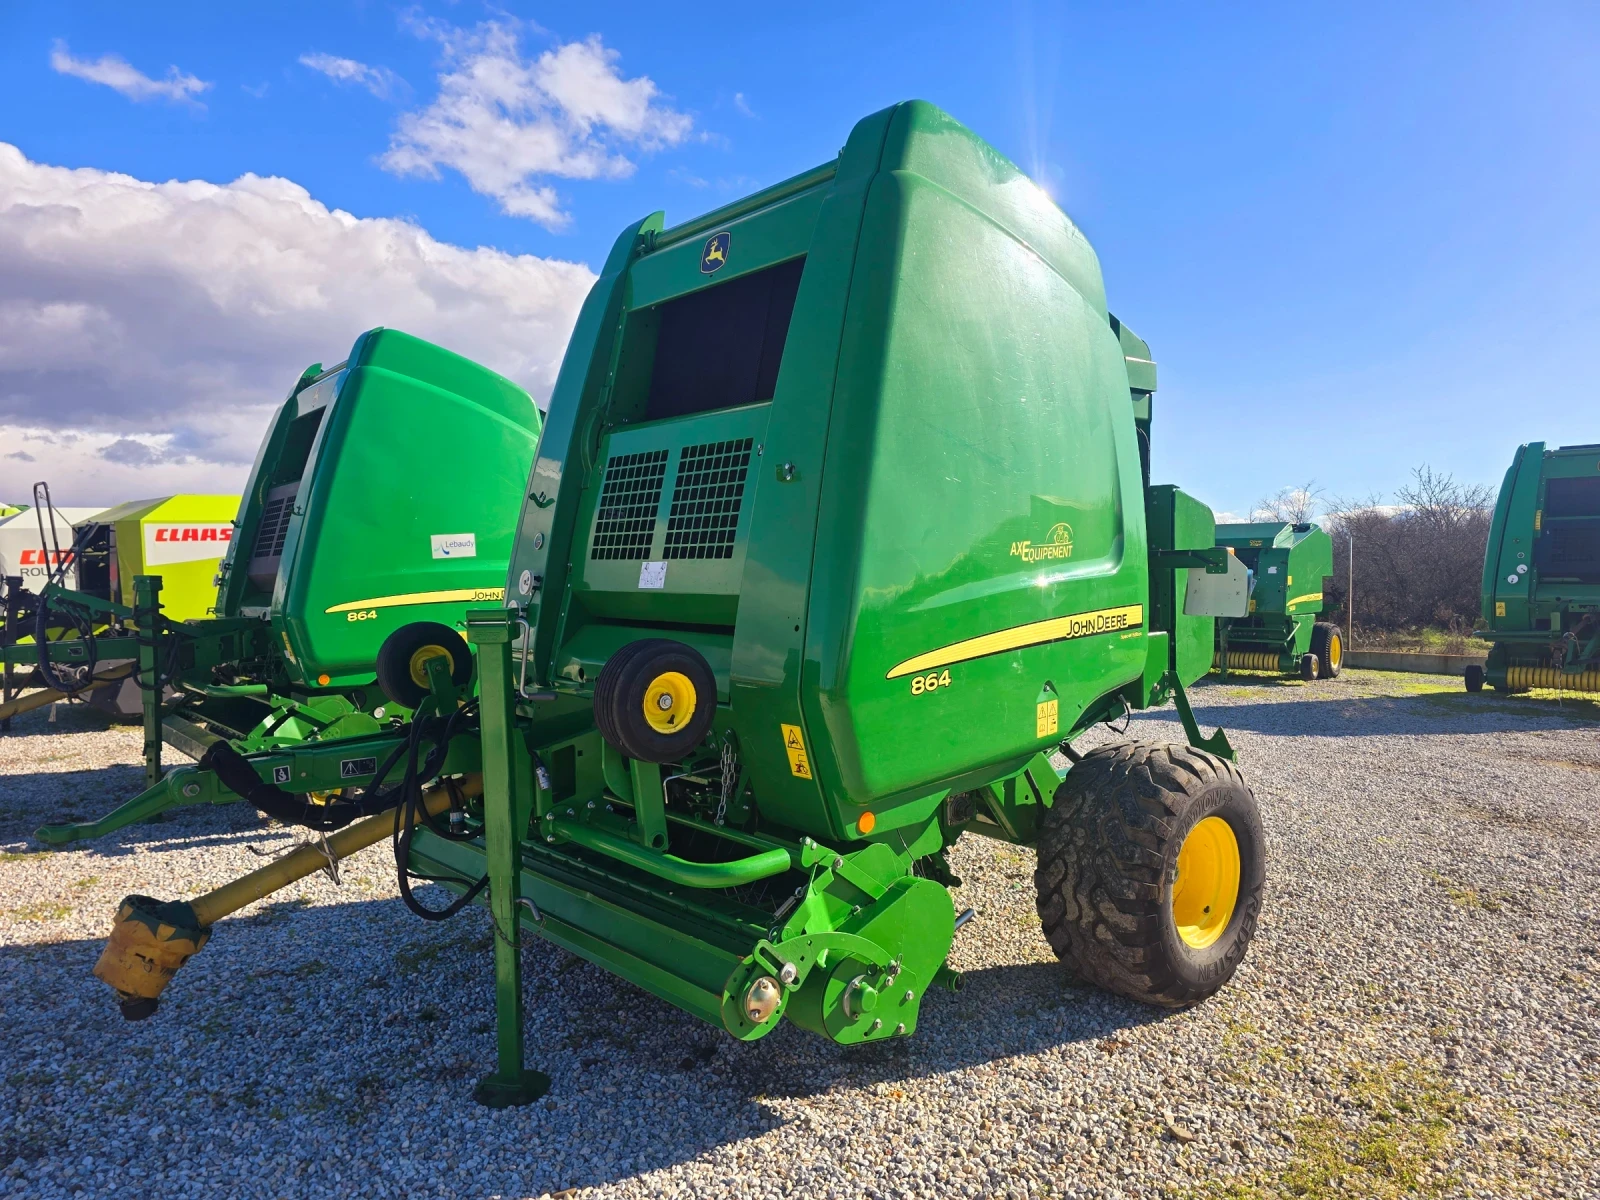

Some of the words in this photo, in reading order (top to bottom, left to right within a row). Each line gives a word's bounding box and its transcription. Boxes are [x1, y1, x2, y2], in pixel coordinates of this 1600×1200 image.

[154, 527, 234, 542] CLAAS
[445, 540, 474, 548] Lebaudy
[471, 591, 500, 600] JOHN
[347, 610, 378, 622] 864
[1066, 619, 1095, 637] JOHN
[1096, 613, 1128, 631] DEERE
[911, 668, 952, 696] 864
